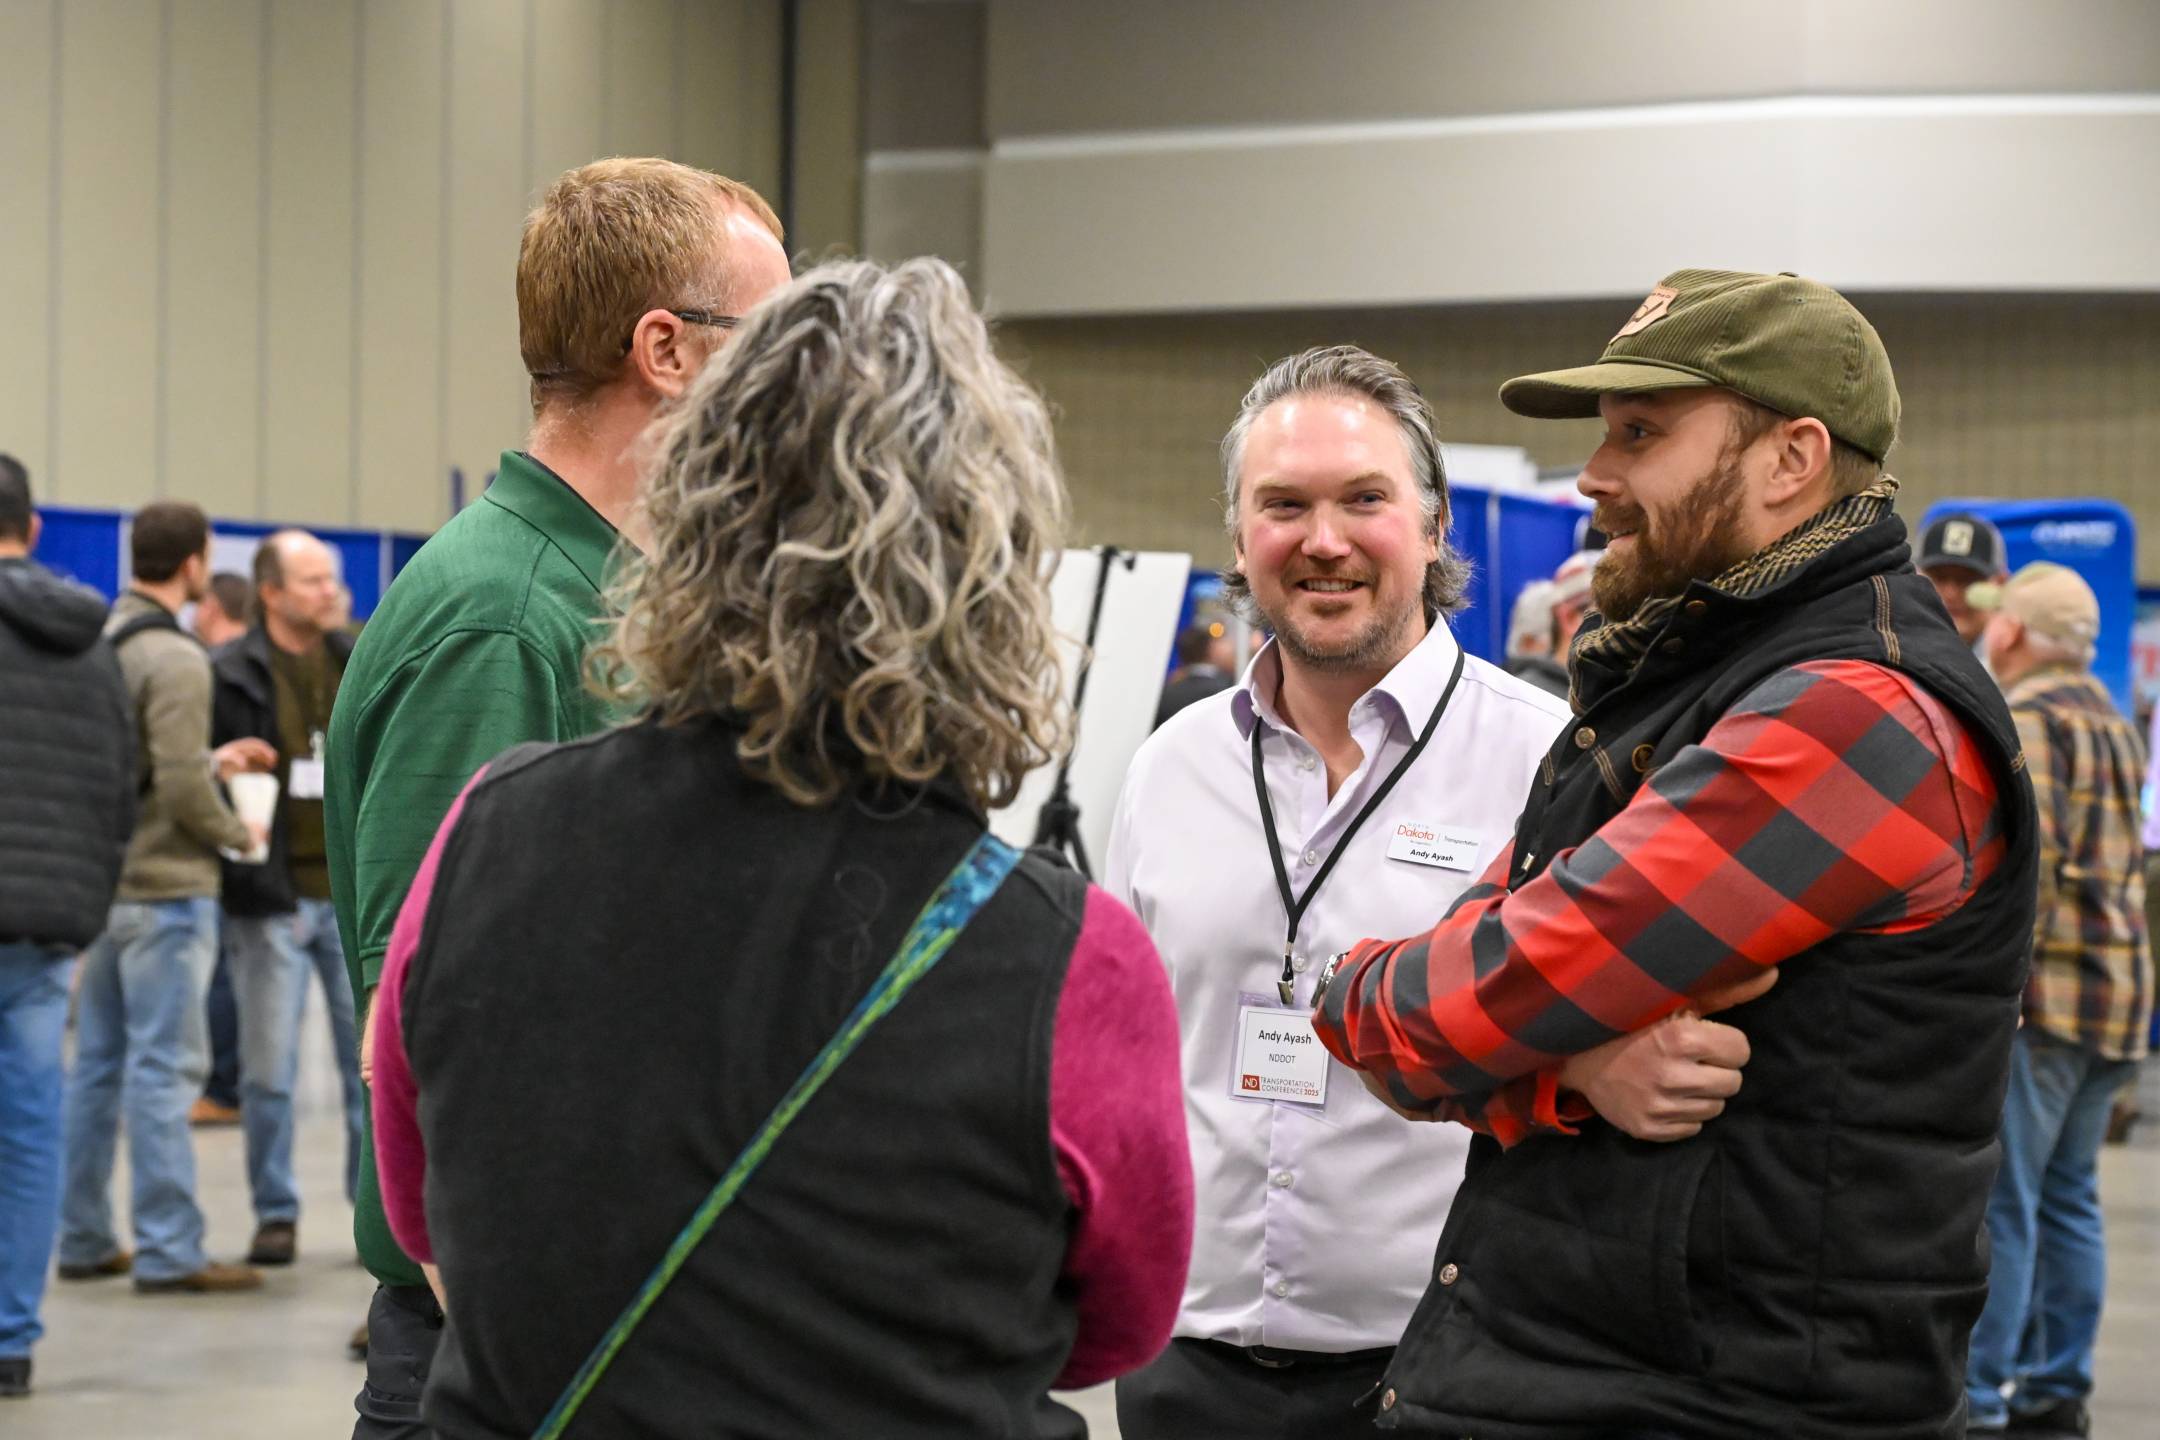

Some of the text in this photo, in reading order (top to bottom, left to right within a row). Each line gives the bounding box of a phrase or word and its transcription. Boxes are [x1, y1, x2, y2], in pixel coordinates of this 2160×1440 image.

[1397, 824, 1434, 841] Dakota
[1444, 835, 1479, 846] Transportation
[1409, 849, 1454, 862] Andy Ayash
[1258, 1029, 1312, 1045] Andy Ayash
[1268, 1053, 1296, 1064] NDDOT
[1244, 1077, 1258, 1089] ND
[1261, 1076, 1315, 1088] TRANSPORTATION
[1261, 1084, 1319, 1097] CONFERENCE 2025
